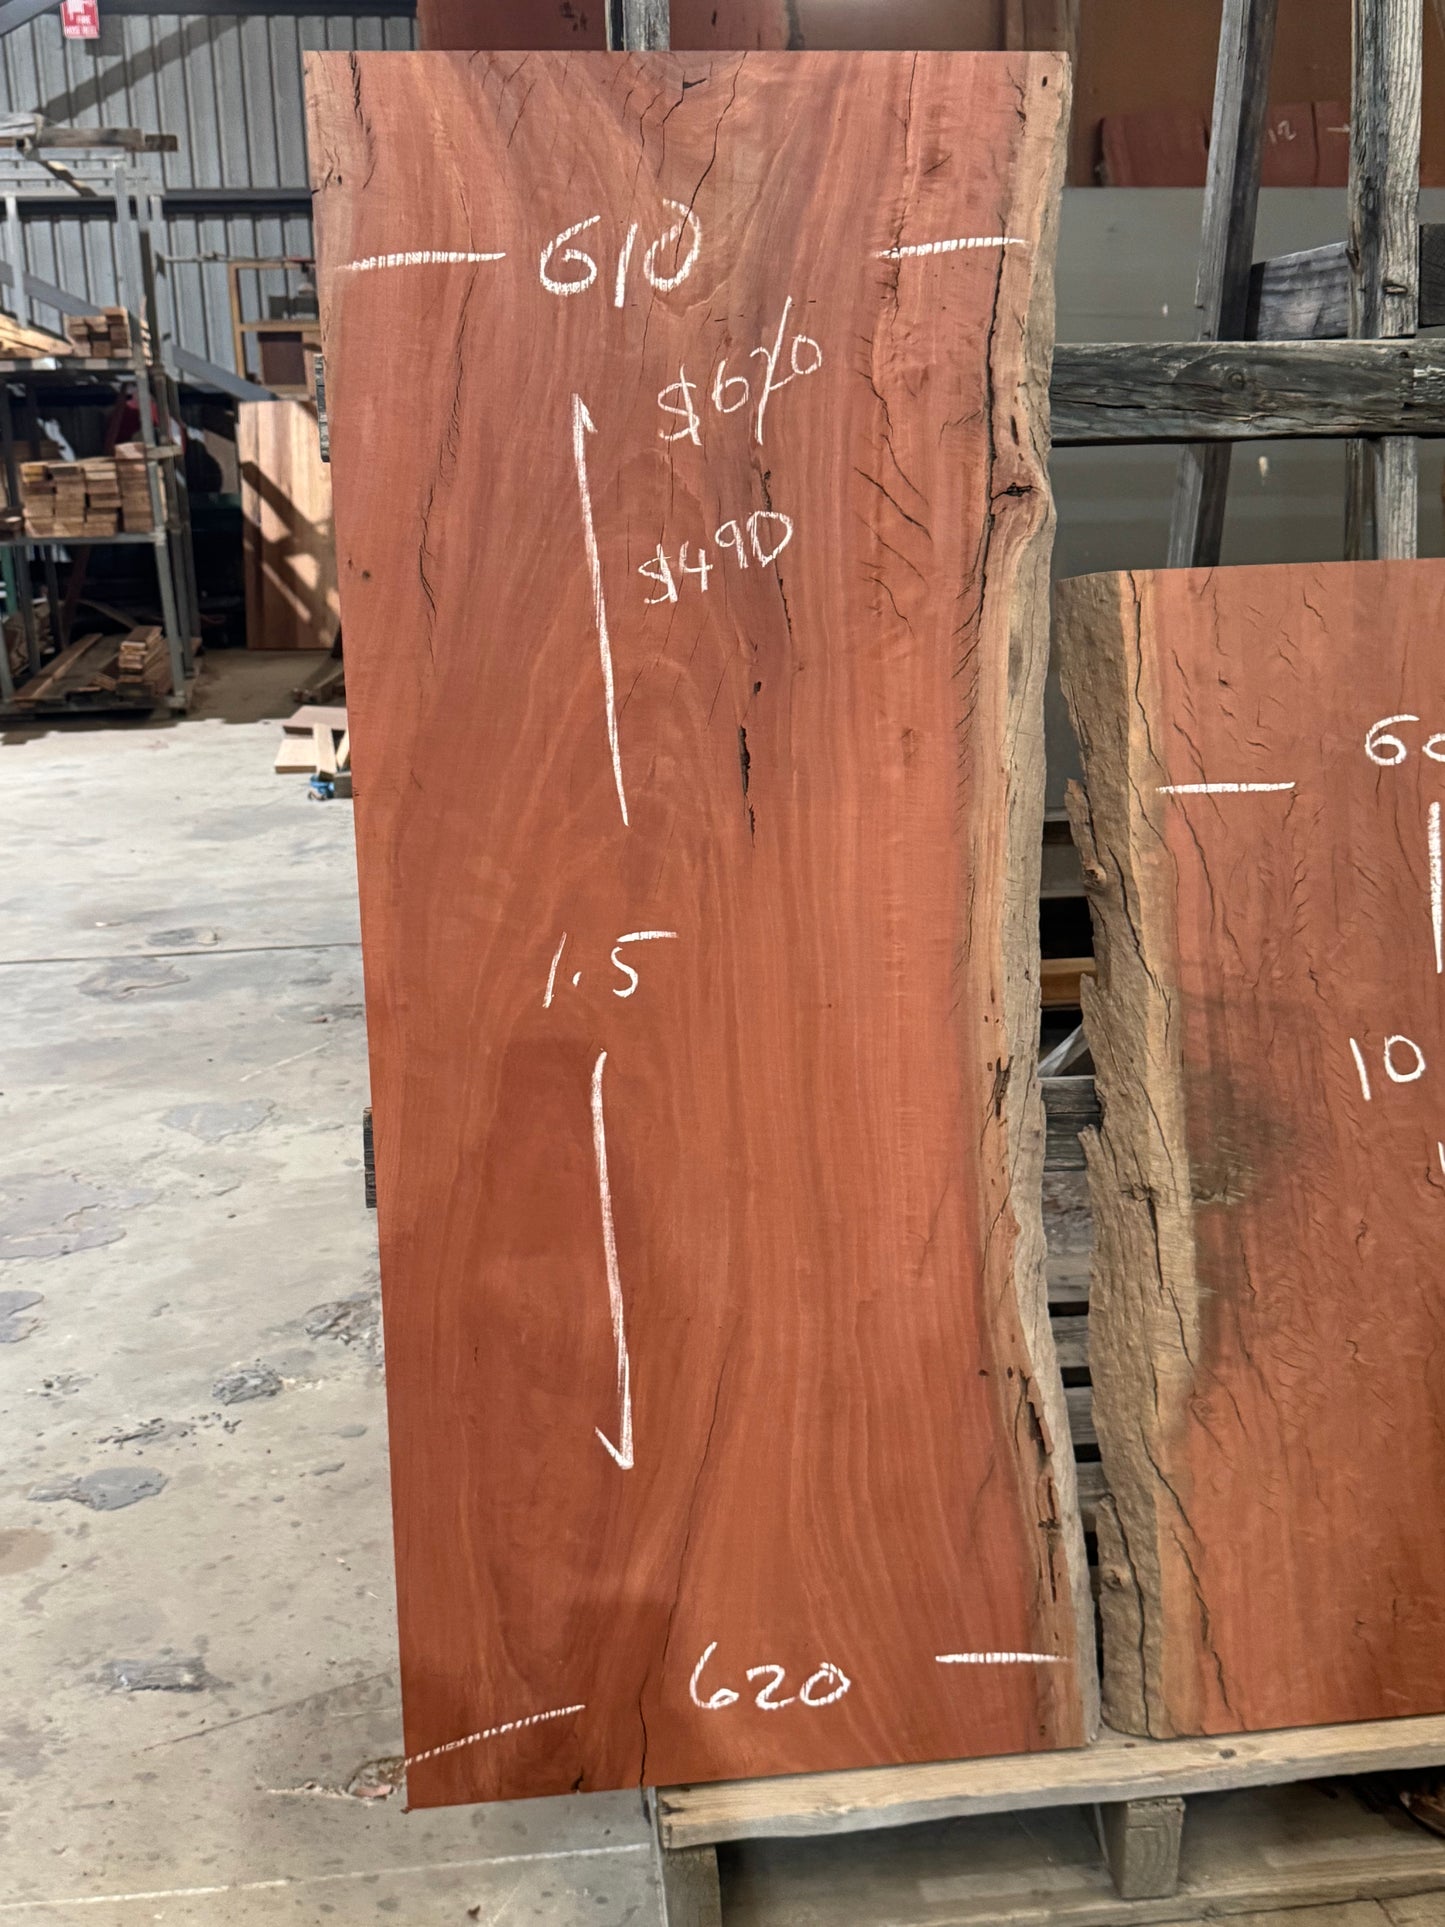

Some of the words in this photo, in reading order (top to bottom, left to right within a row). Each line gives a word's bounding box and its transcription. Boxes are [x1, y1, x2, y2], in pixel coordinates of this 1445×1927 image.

[540, 198, 701, 308] 610
[637, 509, 794, 604] $490
[542, 931, 679, 1009] 1.5
[689, 1640, 851, 1710] 620
